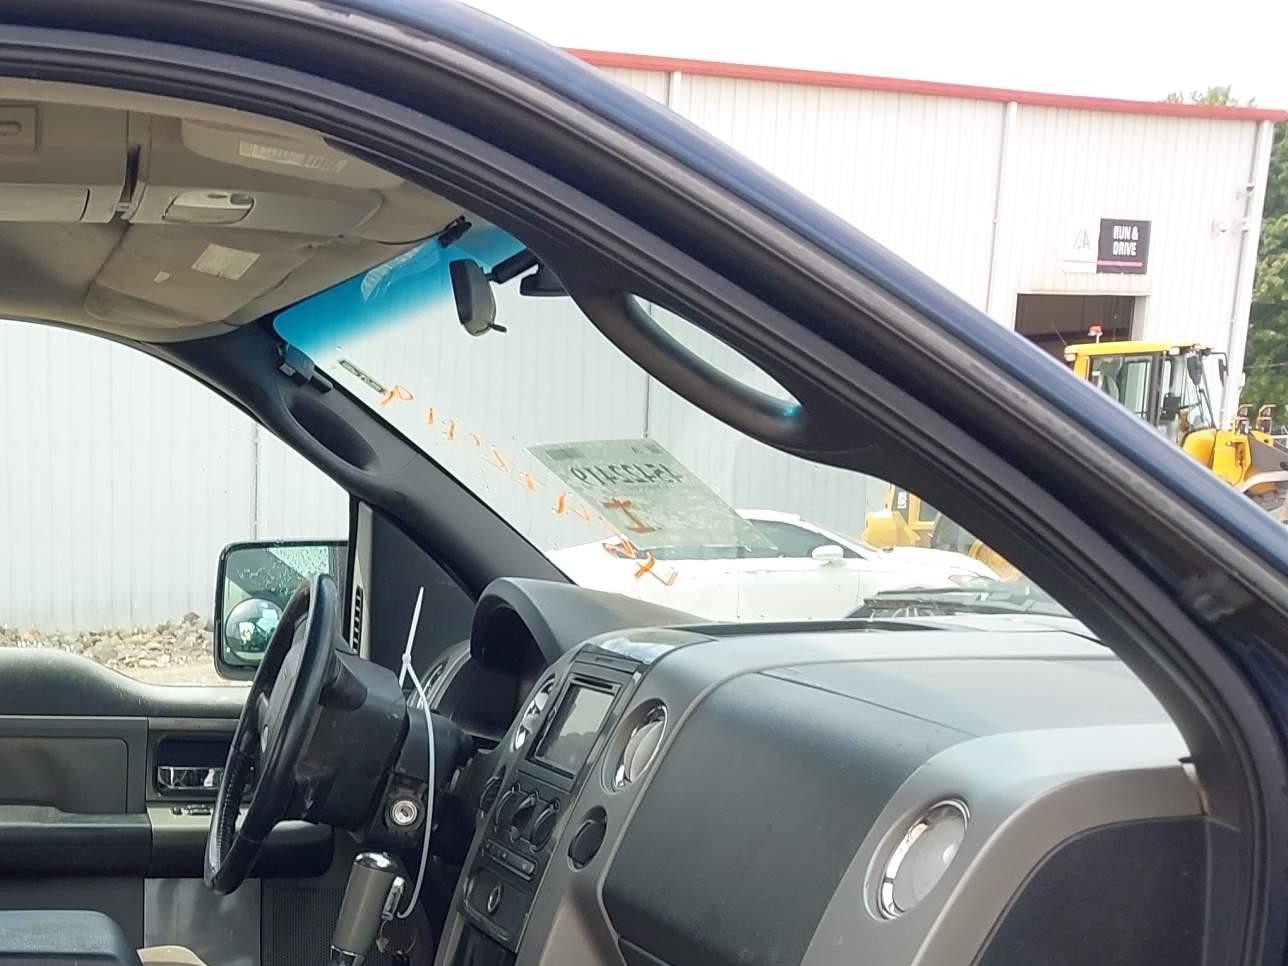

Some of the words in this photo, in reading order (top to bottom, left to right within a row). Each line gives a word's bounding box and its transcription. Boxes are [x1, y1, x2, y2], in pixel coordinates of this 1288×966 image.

[1113, 225, 1131, 241] RUN
[1132, 226, 1139, 241] &
[1113, 241, 1137, 256] DRIVE
